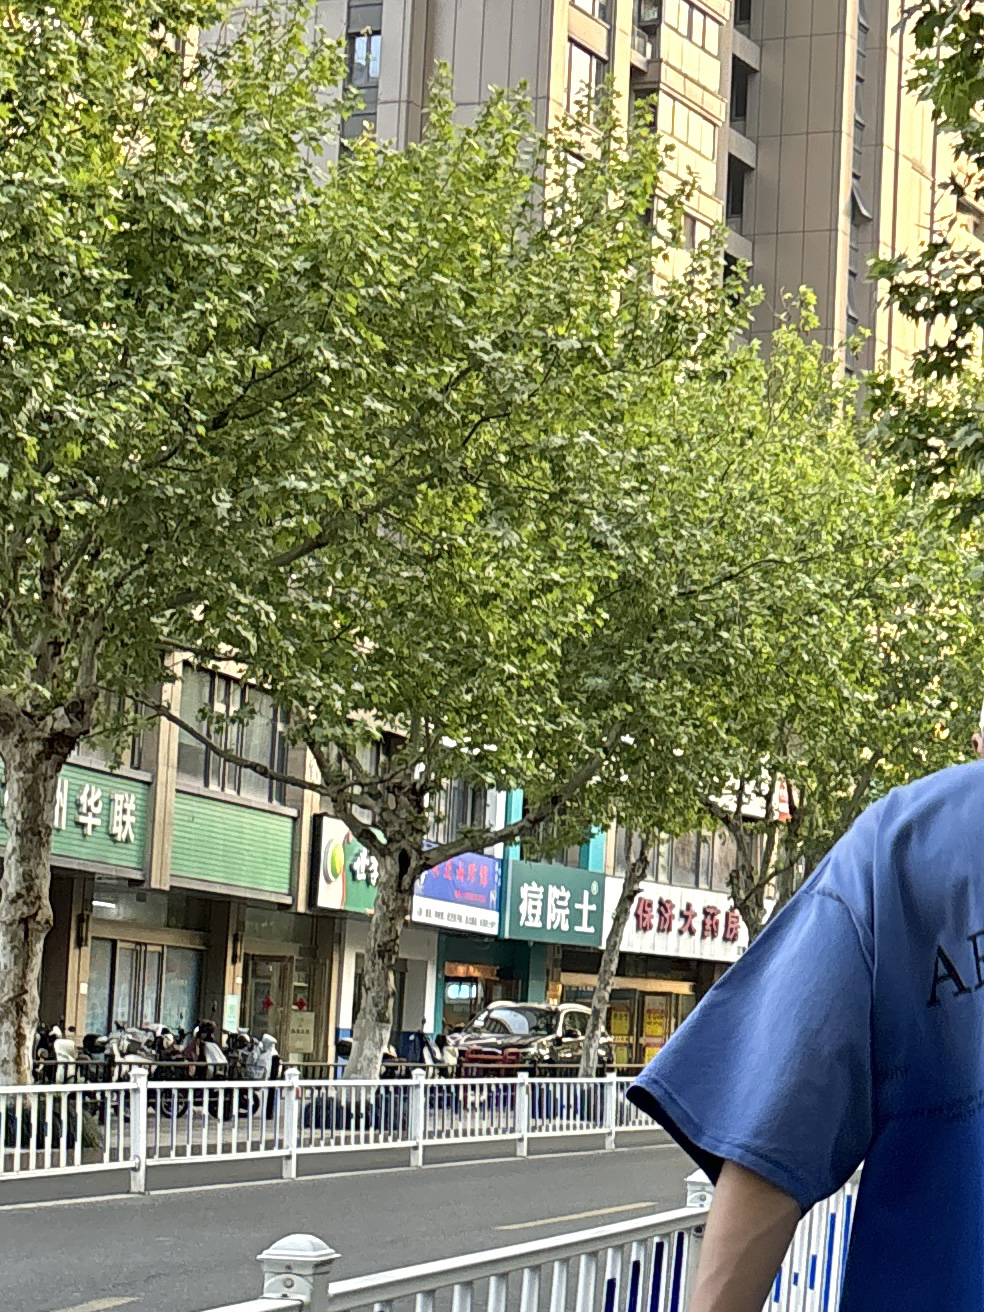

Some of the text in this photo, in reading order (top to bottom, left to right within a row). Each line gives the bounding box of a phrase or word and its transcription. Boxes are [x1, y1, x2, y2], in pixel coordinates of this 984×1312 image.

[518, 880, 598, 934] 痘院士
[633, 895, 742, 943] 保济大药房
